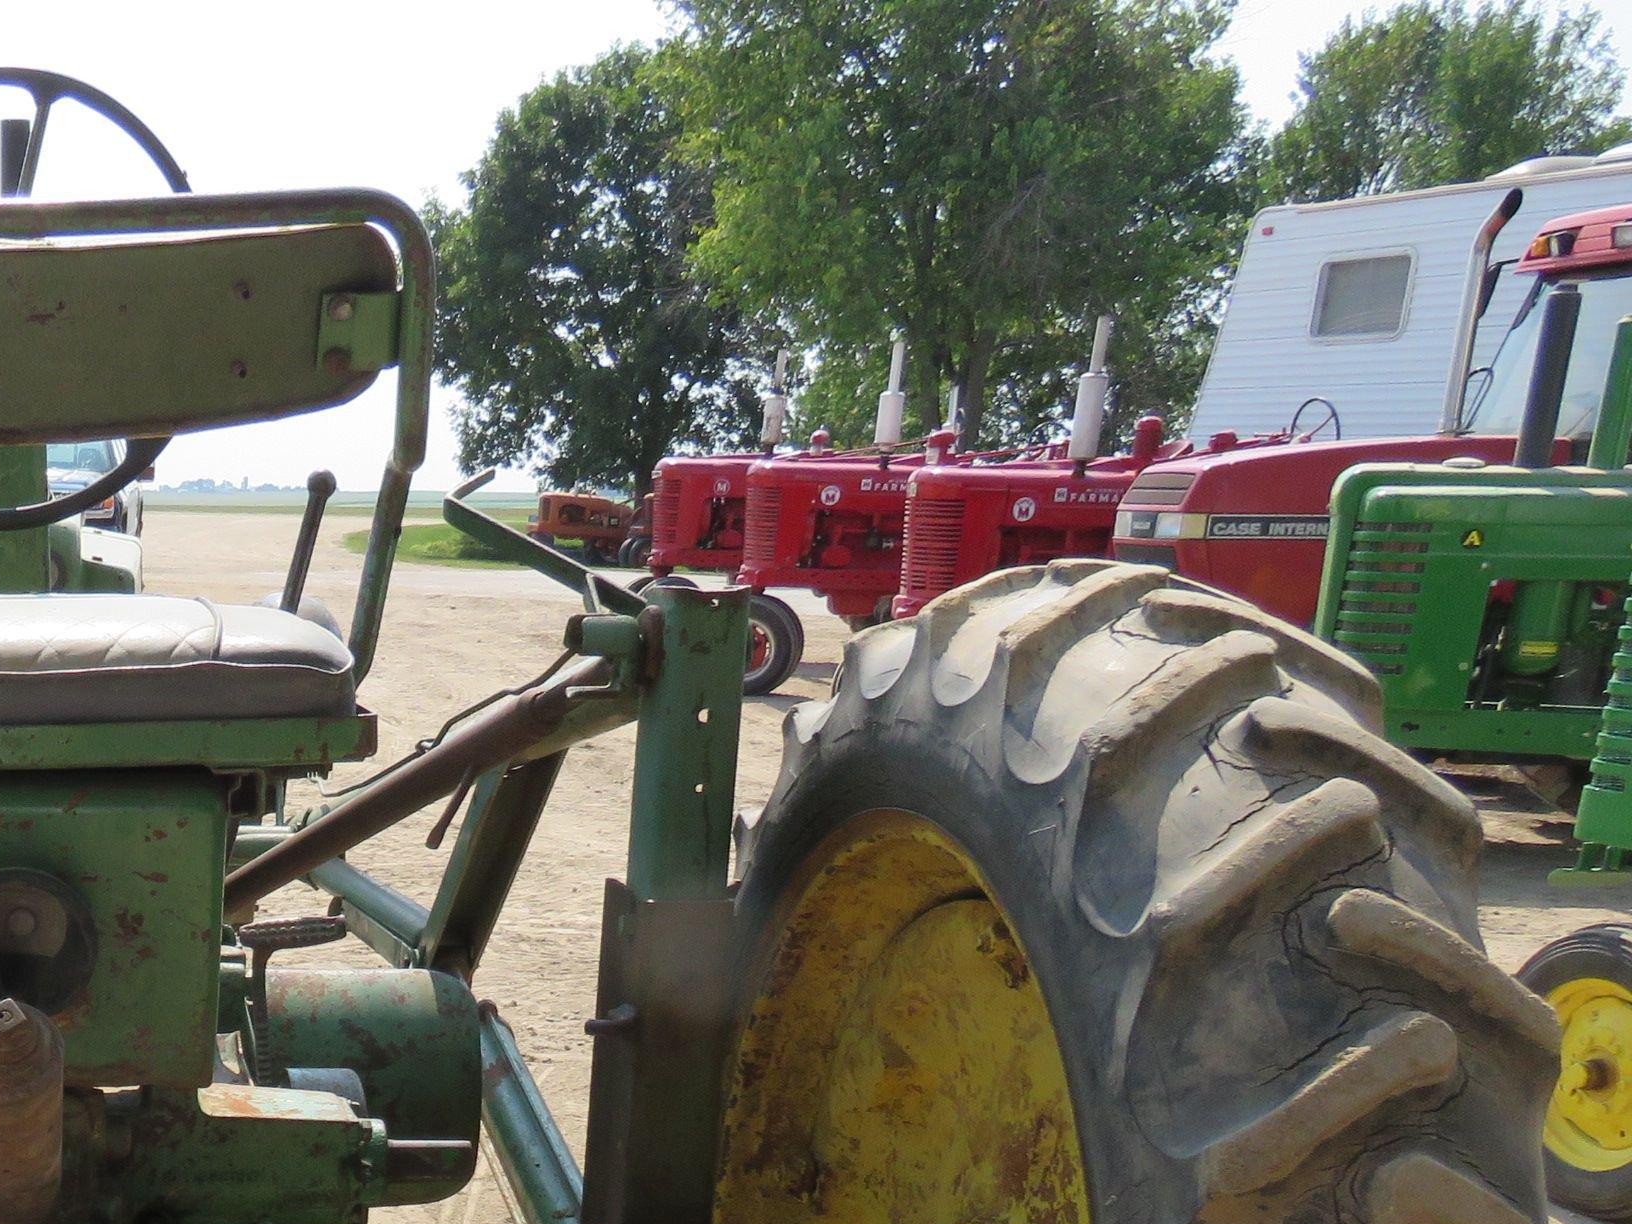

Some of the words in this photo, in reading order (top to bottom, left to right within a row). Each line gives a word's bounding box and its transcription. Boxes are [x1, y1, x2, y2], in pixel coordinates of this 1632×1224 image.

[1213, 522, 1261, 536] CASE
[1268, 522, 1329, 536] INTERN
[1463, 530, 1481, 546] A
